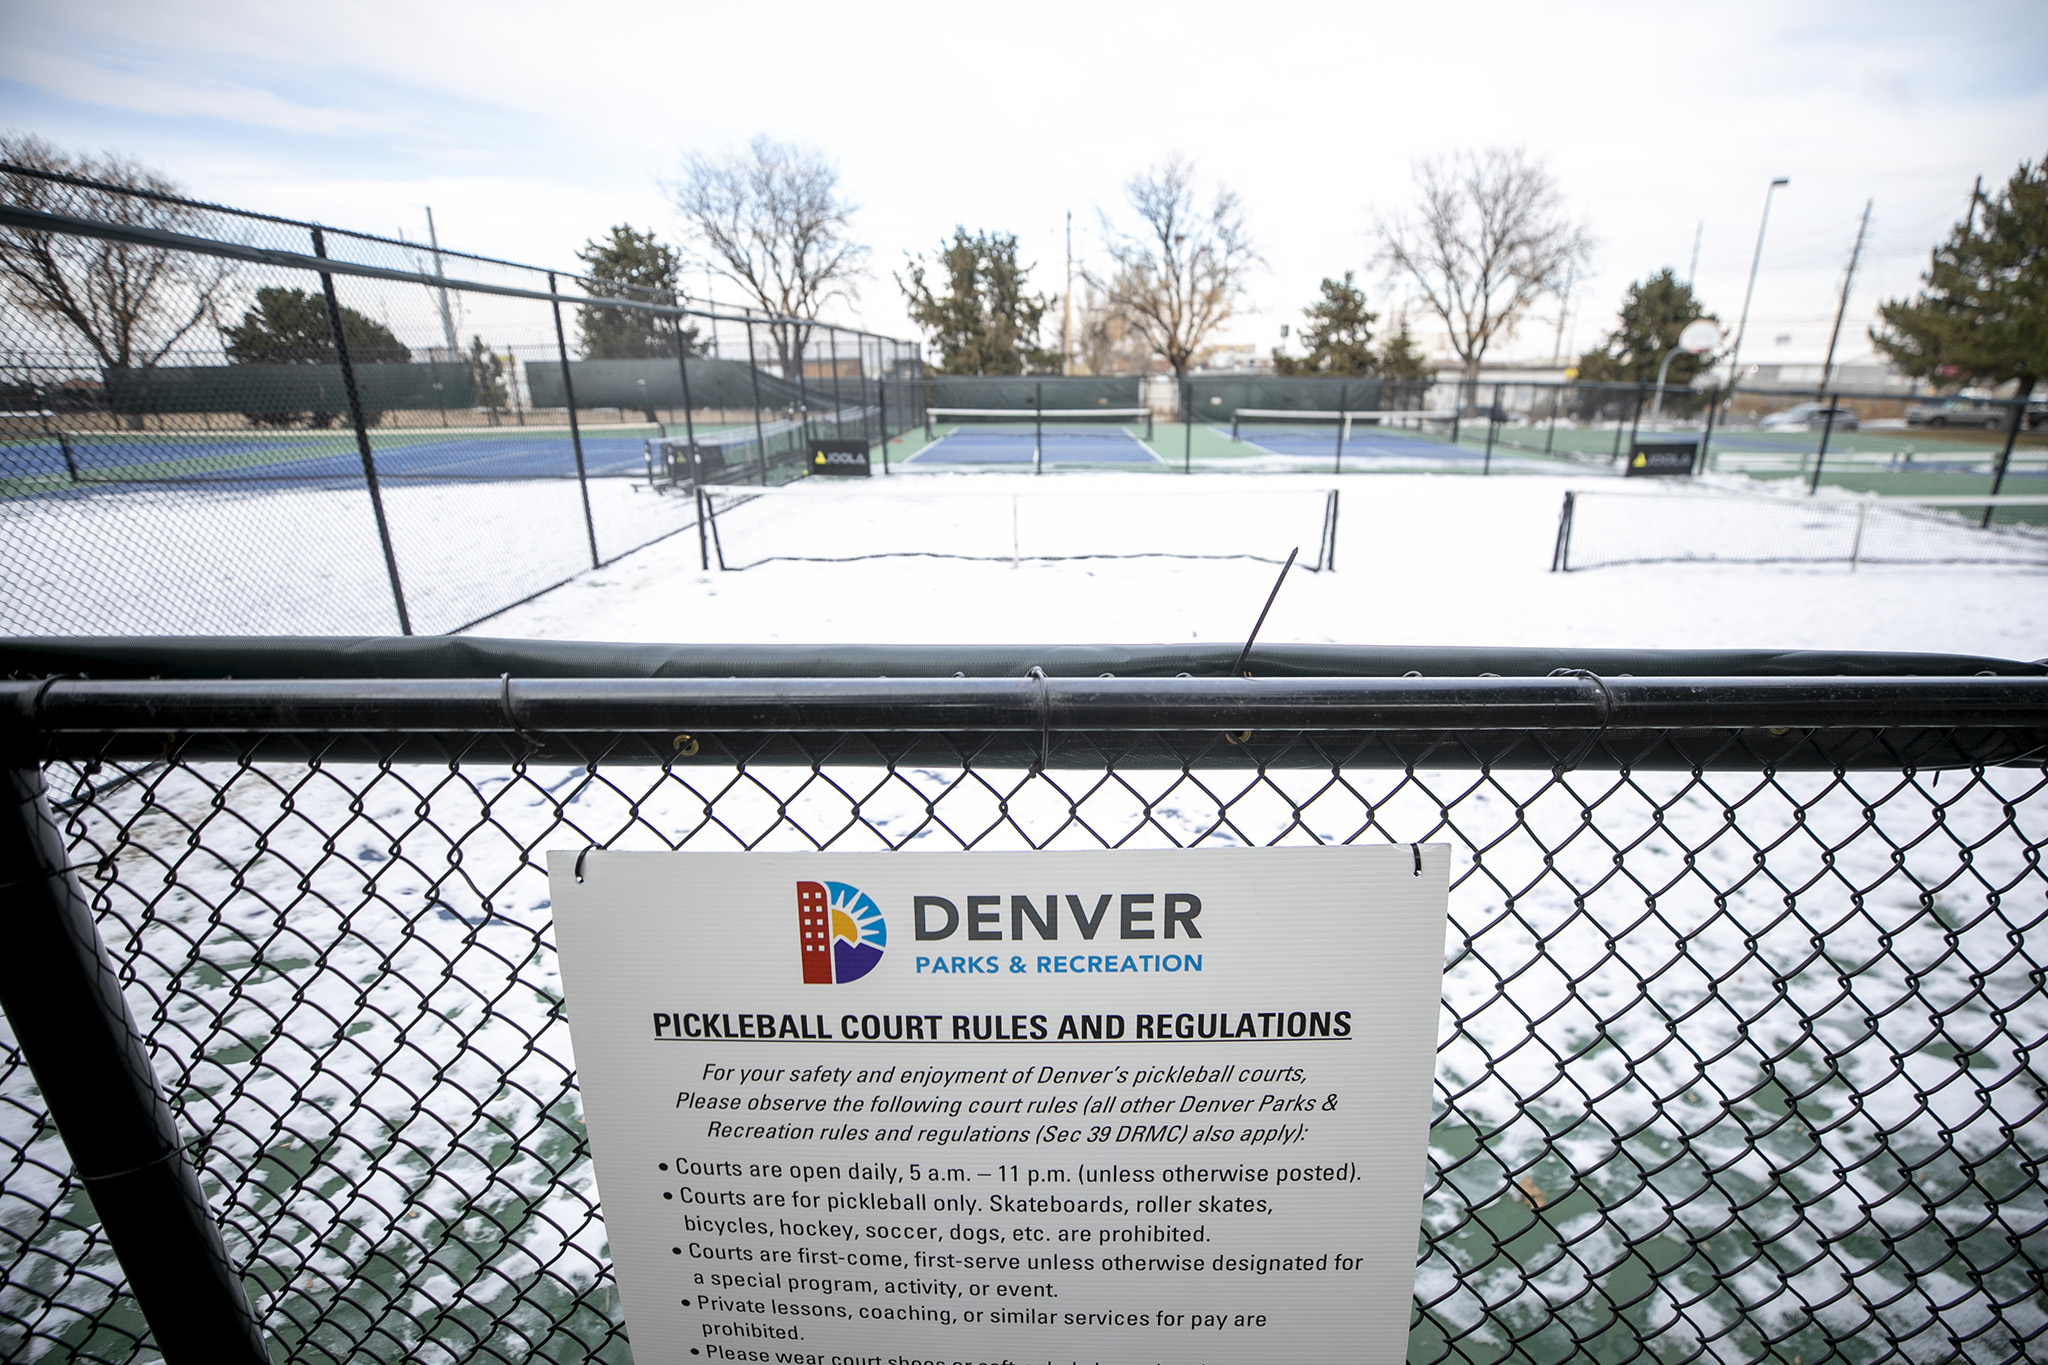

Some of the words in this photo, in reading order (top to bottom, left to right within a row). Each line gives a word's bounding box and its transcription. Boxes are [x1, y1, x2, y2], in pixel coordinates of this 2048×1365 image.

[913, 893, 1203, 941] DENVER
[915, 955, 1000, 974] PARKS
[1008, 955, 1027, 974] &
[1036, 954, 1203, 974] RECREATION
[652, 1012, 833, 1039] PICKLEBALL
[840, 1014, 943, 1039] COURT
[952, 1014, 1049, 1040] RULES
[1057, 1014, 1125, 1039] AND
[1136, 1010, 1352, 1038] REGULATIONS
[702, 1063, 736, 1081] For
[739, 1068, 786, 1086] your
[789, 1064, 853, 1087] safety
[856, 1065, 897, 1084] and
[900, 1065, 1009, 1088] enjoyment
[1011, 1065, 1036, 1085] of
[1131, 1064, 1236, 1088] pickleball
[1238, 1065, 1307, 1085] courts,
[675, 1091, 742, 1111] Please
[747, 1093, 827, 1112] observe
[832, 1094, 865, 1113] the
[870, 1094, 963, 1118] following
[968, 1098, 1024, 1114] court
[1026, 1095, 1079, 1114] rules
[1083, 1095, 1118, 1117] (all
[1119, 1095, 1177, 1114] other
[1178, 1095, 1256, 1113] Denver
[1257, 1093, 1317, 1113] Parks
[1321, 1093, 1339, 1112] &
[707, 1120, 815, 1140] Recreation
[819, 1123, 870, 1141] rules
[874, 1124, 914, 1142] and
[917, 1124, 1031, 1146] regulations
[1035, 1124, 1082, 1145] (Sec
[1086, 1125, 1112, 1143] 39
[1115, 1124, 1189, 1145] DRMC)
[1192, 1124, 1235, 1143] also
[1239, 1122, 1309, 1146] apply):
[675, 1157, 743, 1177] Courts
[749, 1164, 783, 1178] are
[789, 1165, 841, 1183] open
[848, 1162, 904, 1185] daily,
[909, 1163, 921, 1181] 5
[928, 1168, 971, 1182] a.m.
[998, 1164, 1018, 1183] 11
[1028, 1169, 1071, 1187] p.m.
[1078, 1163, 1155, 1186] (unless
[1162, 1163, 1269, 1183] otherwise
[1276, 1161, 1361, 1186] posted).
[679, 1186, 746, 1206] Courts
[752, 1193, 786, 1208] are
[791, 1190, 821, 1209] for
[827, 1191, 927, 1213] pickleball
[933, 1193, 983, 1216] only.
[989, 1194, 1129, 1216] Skateboards,
[1136, 1195, 1193, 1214] roller
[1198, 1194, 1273, 1216] skates,
[683, 1214, 774, 1238] bicycles,
[779, 1218, 860, 1242] hockey,
[865, 1225, 943, 1243] soccer,
[949, 1223, 1006, 1245] dogs,
[1012, 1226, 1051, 1242] etc.
[1058, 1228, 1092, 1243] are
[1099, 1224, 1211, 1247] prohibited.
[688, 1242, 754, 1262] Courts
[759, 1249, 792, 1263] are
[797, 1247, 909, 1270] first-come,
[913, 1250, 1020, 1270] first-serve
[1027, 1253, 1095, 1271] unless
[1101, 1253, 1205, 1272] otherwise
[1212, 1253, 1328, 1276] designated
[1333, 1253, 1364, 1271] for
[693, 1272, 705, 1285] a
[710, 1272, 782, 1290] special
[788, 1277, 878, 1296] program,
[884, 1278, 963, 1299] activity,
[969, 1283, 990, 1297] or
[996, 1283, 1058, 1298] event.
[697, 1294, 766, 1314] Private
[771, 1298, 853, 1321] lessons,
[859, 1304, 957, 1326] coaching,
[963, 1310, 984, 1323] or
[990, 1307, 1058, 1325] similar
[1063, 1309, 1150, 1327] services
[1155, 1310, 1185, 1327] for
[1191, 1314, 1228, 1331] pay
[1233, 1314, 1267, 1328] are
[701, 1321, 805, 1341] prohibited.
[705, 1344, 770, 1363] Please
[774, 1352, 825, 1365] wear
[831, 1355, 883, 1365] court
